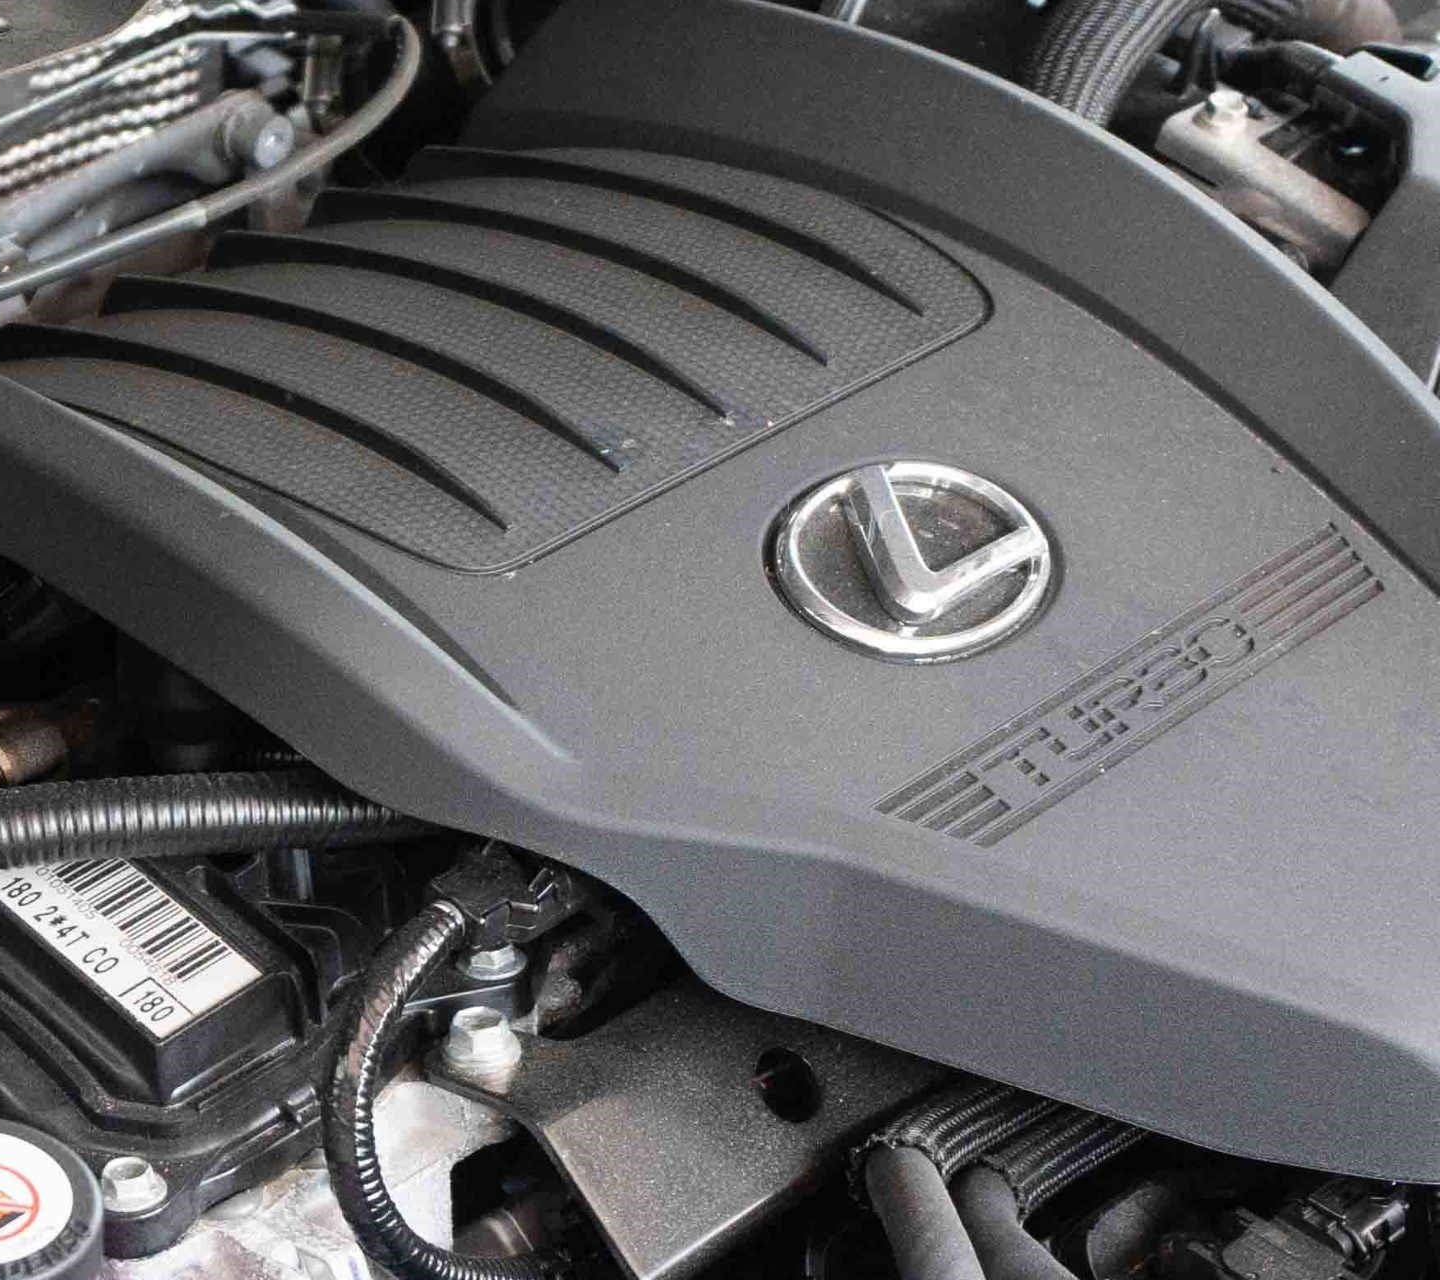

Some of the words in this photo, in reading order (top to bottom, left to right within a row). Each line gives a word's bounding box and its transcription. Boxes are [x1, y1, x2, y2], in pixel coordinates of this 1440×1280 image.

[975, 615, 1257, 787] TURBO
[1, 875, 42, 908] 180
[132, 990, 175, 1023] 180
